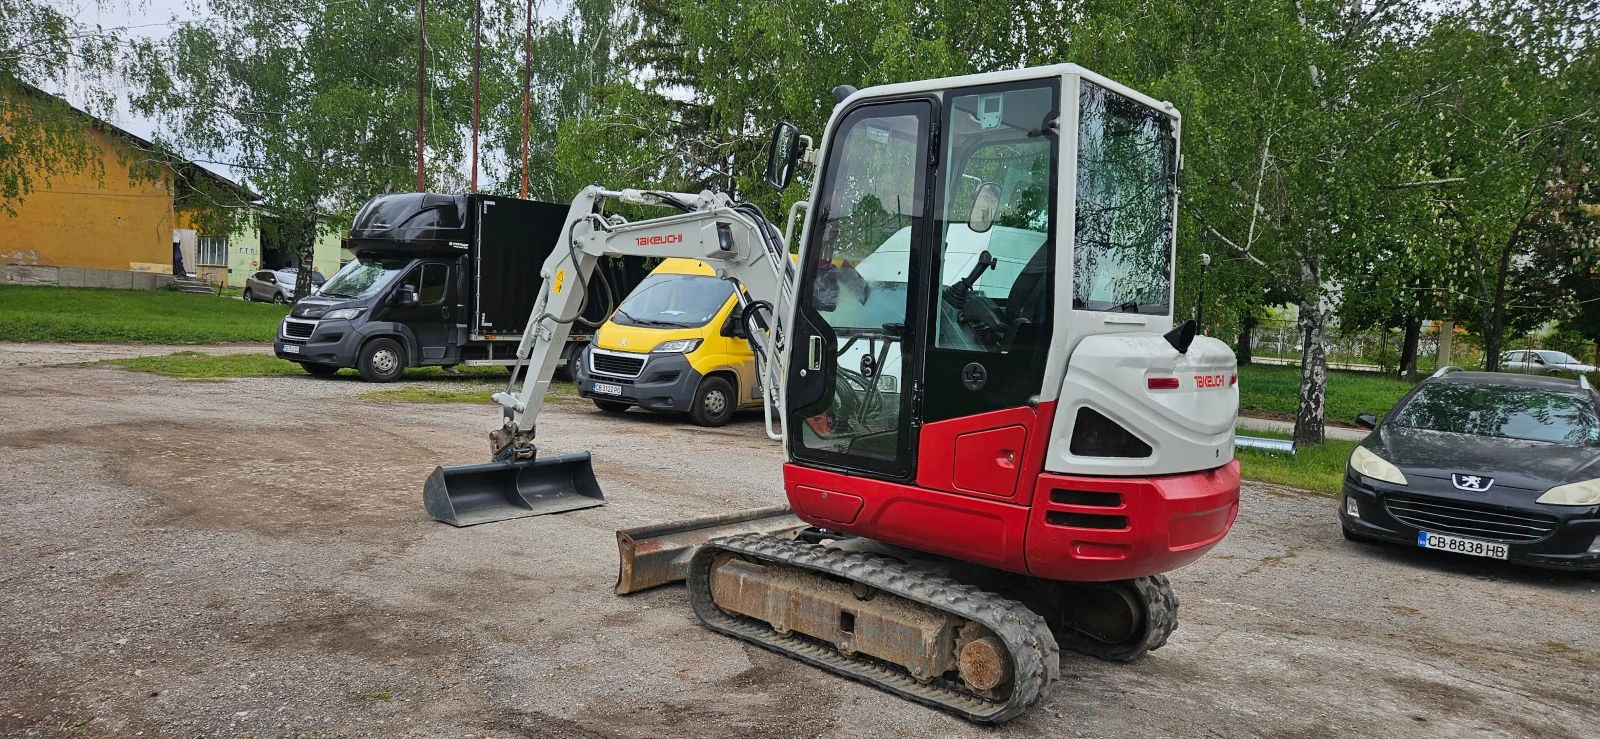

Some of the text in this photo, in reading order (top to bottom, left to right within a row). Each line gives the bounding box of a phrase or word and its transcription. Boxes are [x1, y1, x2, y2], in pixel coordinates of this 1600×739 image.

[1428, 535, 1505, 558] CB 8838 HB
